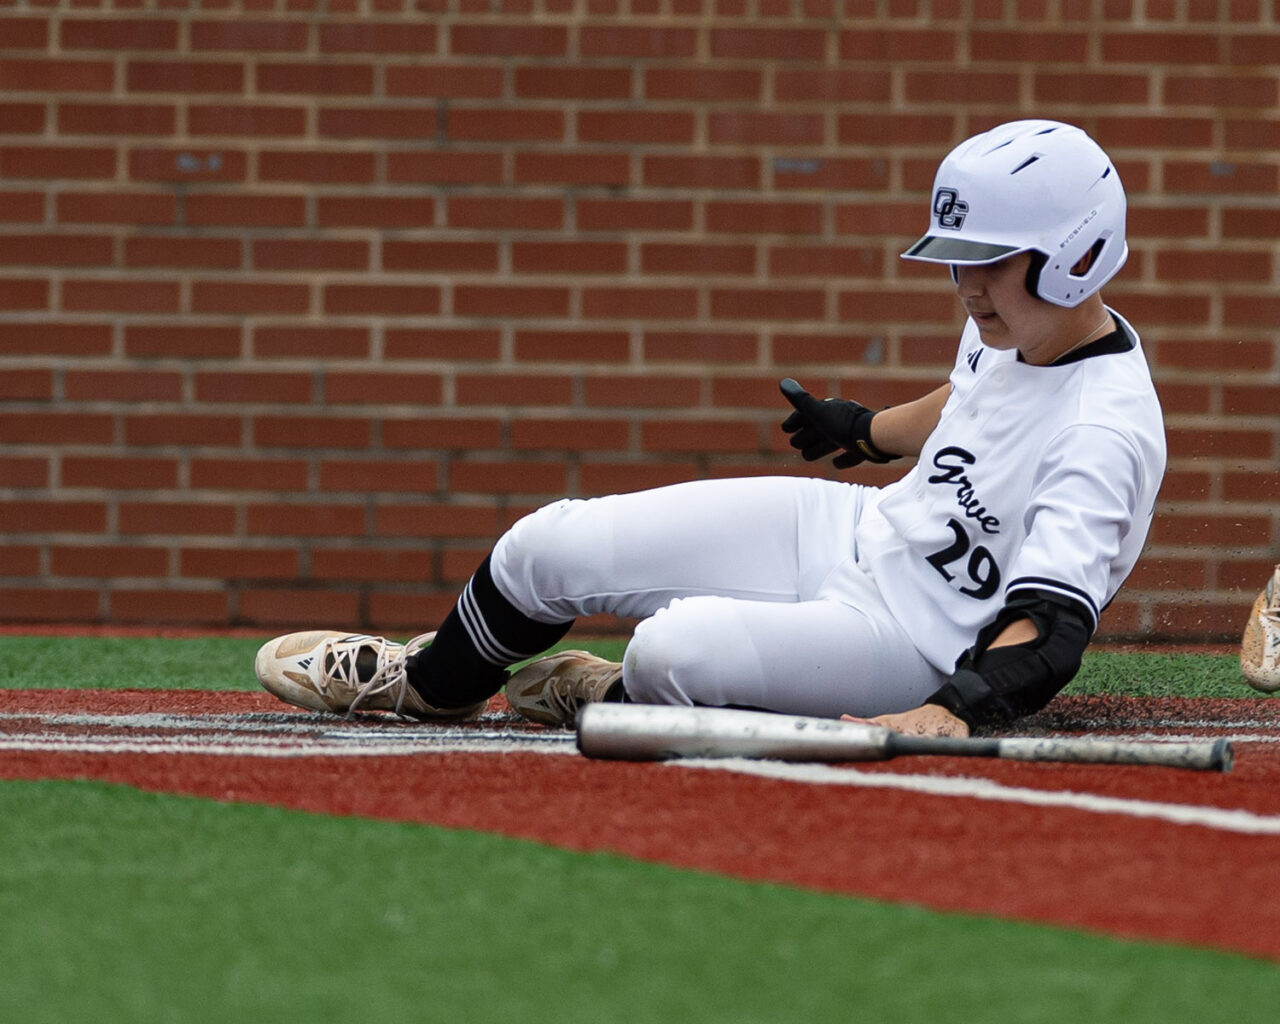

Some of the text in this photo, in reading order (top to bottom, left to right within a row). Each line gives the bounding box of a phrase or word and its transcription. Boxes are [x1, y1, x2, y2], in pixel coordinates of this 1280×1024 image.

[933, 187, 969, 231] OG
[928, 446, 1000, 534] Grove
[925, 518, 1001, 601] 29
